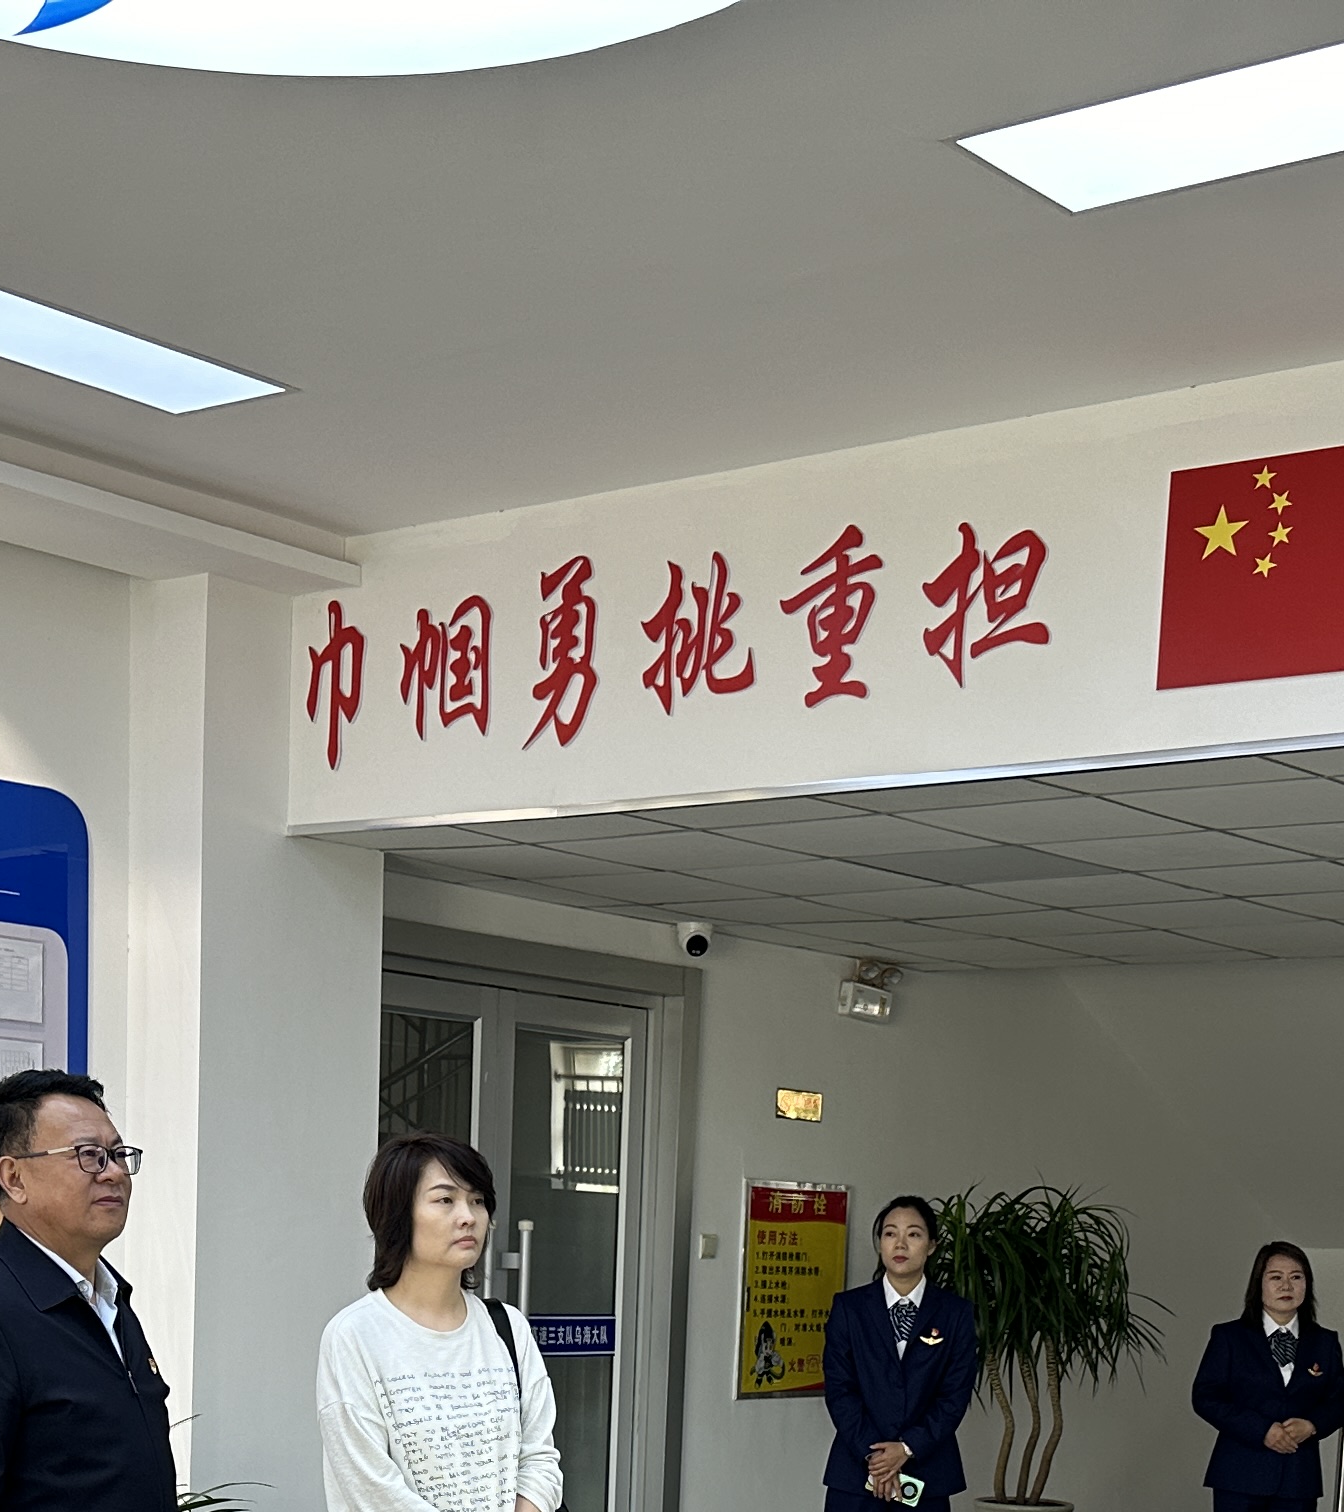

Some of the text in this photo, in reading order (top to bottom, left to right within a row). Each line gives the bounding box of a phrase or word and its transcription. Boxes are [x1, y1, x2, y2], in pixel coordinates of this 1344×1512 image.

[306, 522, 1052, 771] 巾帼勇挑重担
